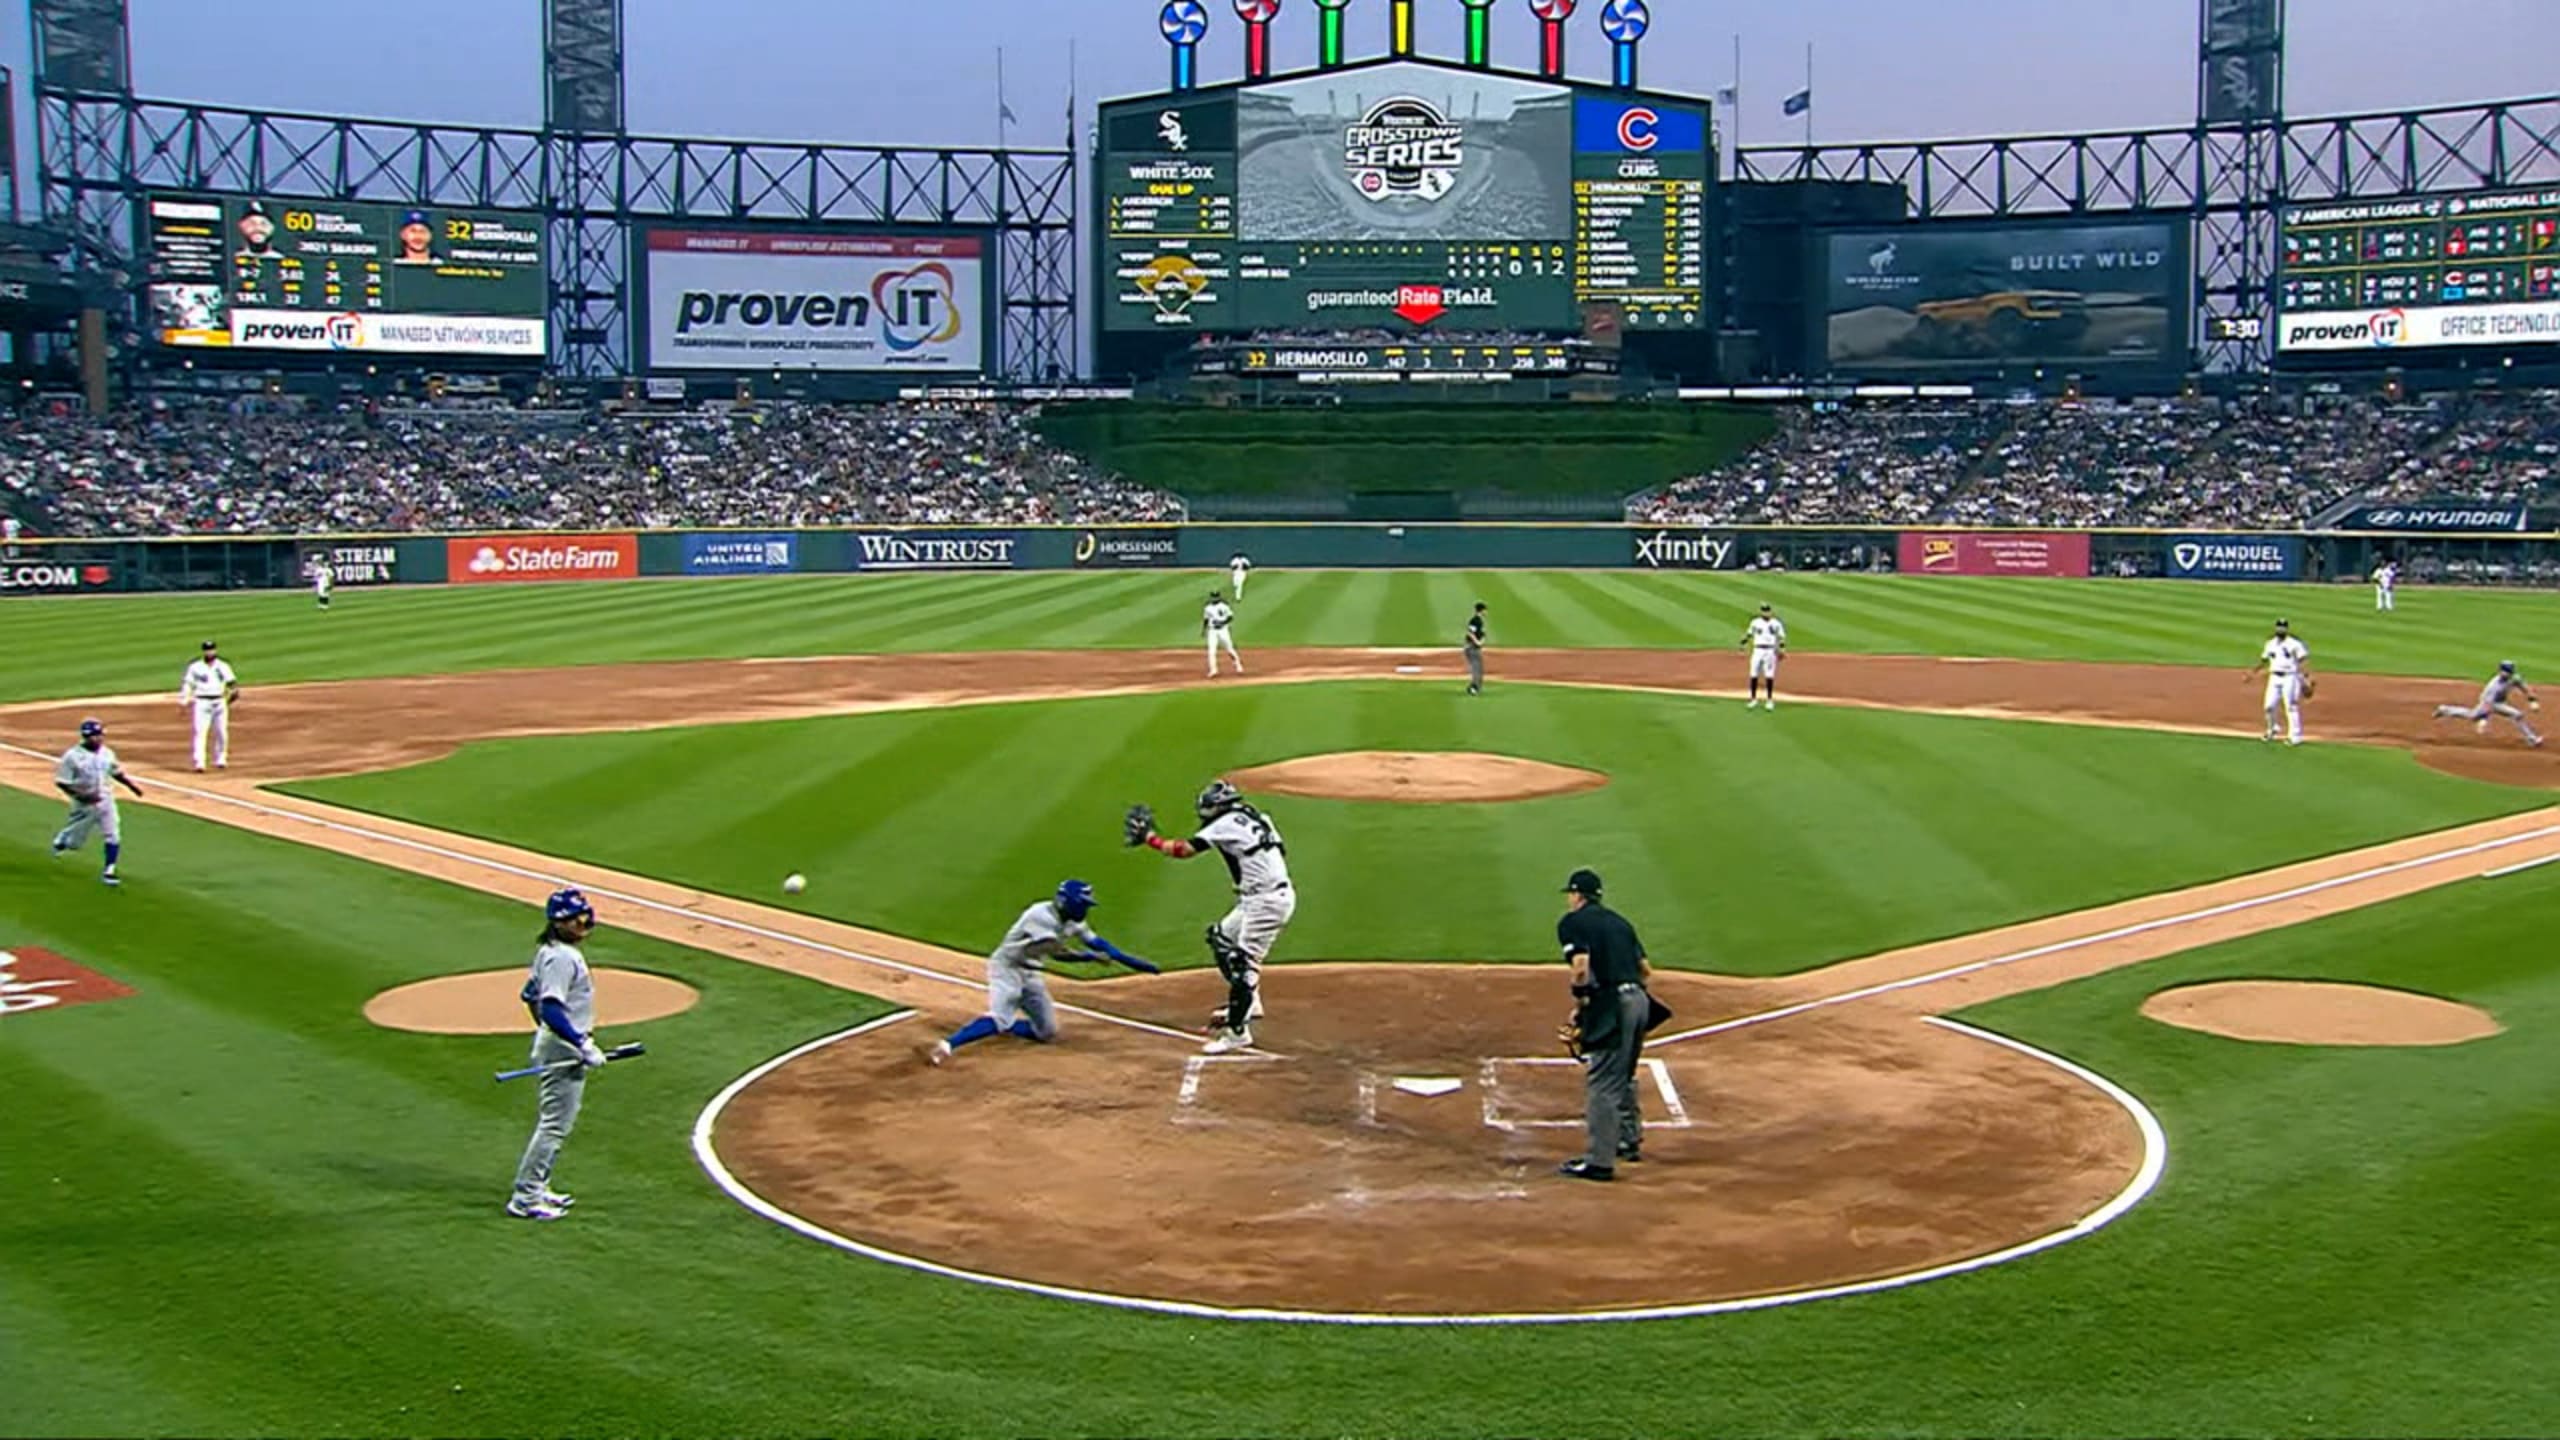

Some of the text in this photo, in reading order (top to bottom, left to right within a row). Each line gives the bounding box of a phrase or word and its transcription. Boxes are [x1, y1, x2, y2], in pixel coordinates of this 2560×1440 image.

[1346, 127, 1462, 147] CROSSTOWN
[1344, 136, 1463, 166] SERIES
[1129, 167, 1215, 179] WHITE SOX
[2468, 194, 2539, 210] NATIONAL
[284, 210, 314, 231] 60
[2303, 202, 2422, 222] AMERICAN LEAGUE
[446, 219, 471, 240] 32
[1509, 260, 1523, 275] 0
[1531, 260, 1543, 275] 1
[1551, 260, 1565, 275] 2
[2011, 250, 2161, 271] BUILT WILD
[1307, 289, 1399, 310] guaranteed
[1401, 288, 1440, 304] Rate
[676, 288, 938, 333] proven IT
[243, 323, 355, 341] proven IT
[2290, 320, 2399, 344] proven IT
[2441, 316, 2487, 337] OFFICE
[1248, 351, 1369, 367] 32 HERMOSILLO
[2407, 510, 2513, 527] HYUNDAI
[334, 546, 396, 564] STREAM
[706, 543, 763, 553] UNITED
[858, 535, 1014, 562] WINTRUST
[1100, 540, 1177, 554] HORSESHOE
[1636, 530, 1732, 569] xfinity
[2204, 545, 2284, 561] FANDUEL
[693, 554, 763, 565] AIRLINES
[335, 565, 376, 581] YOUR
